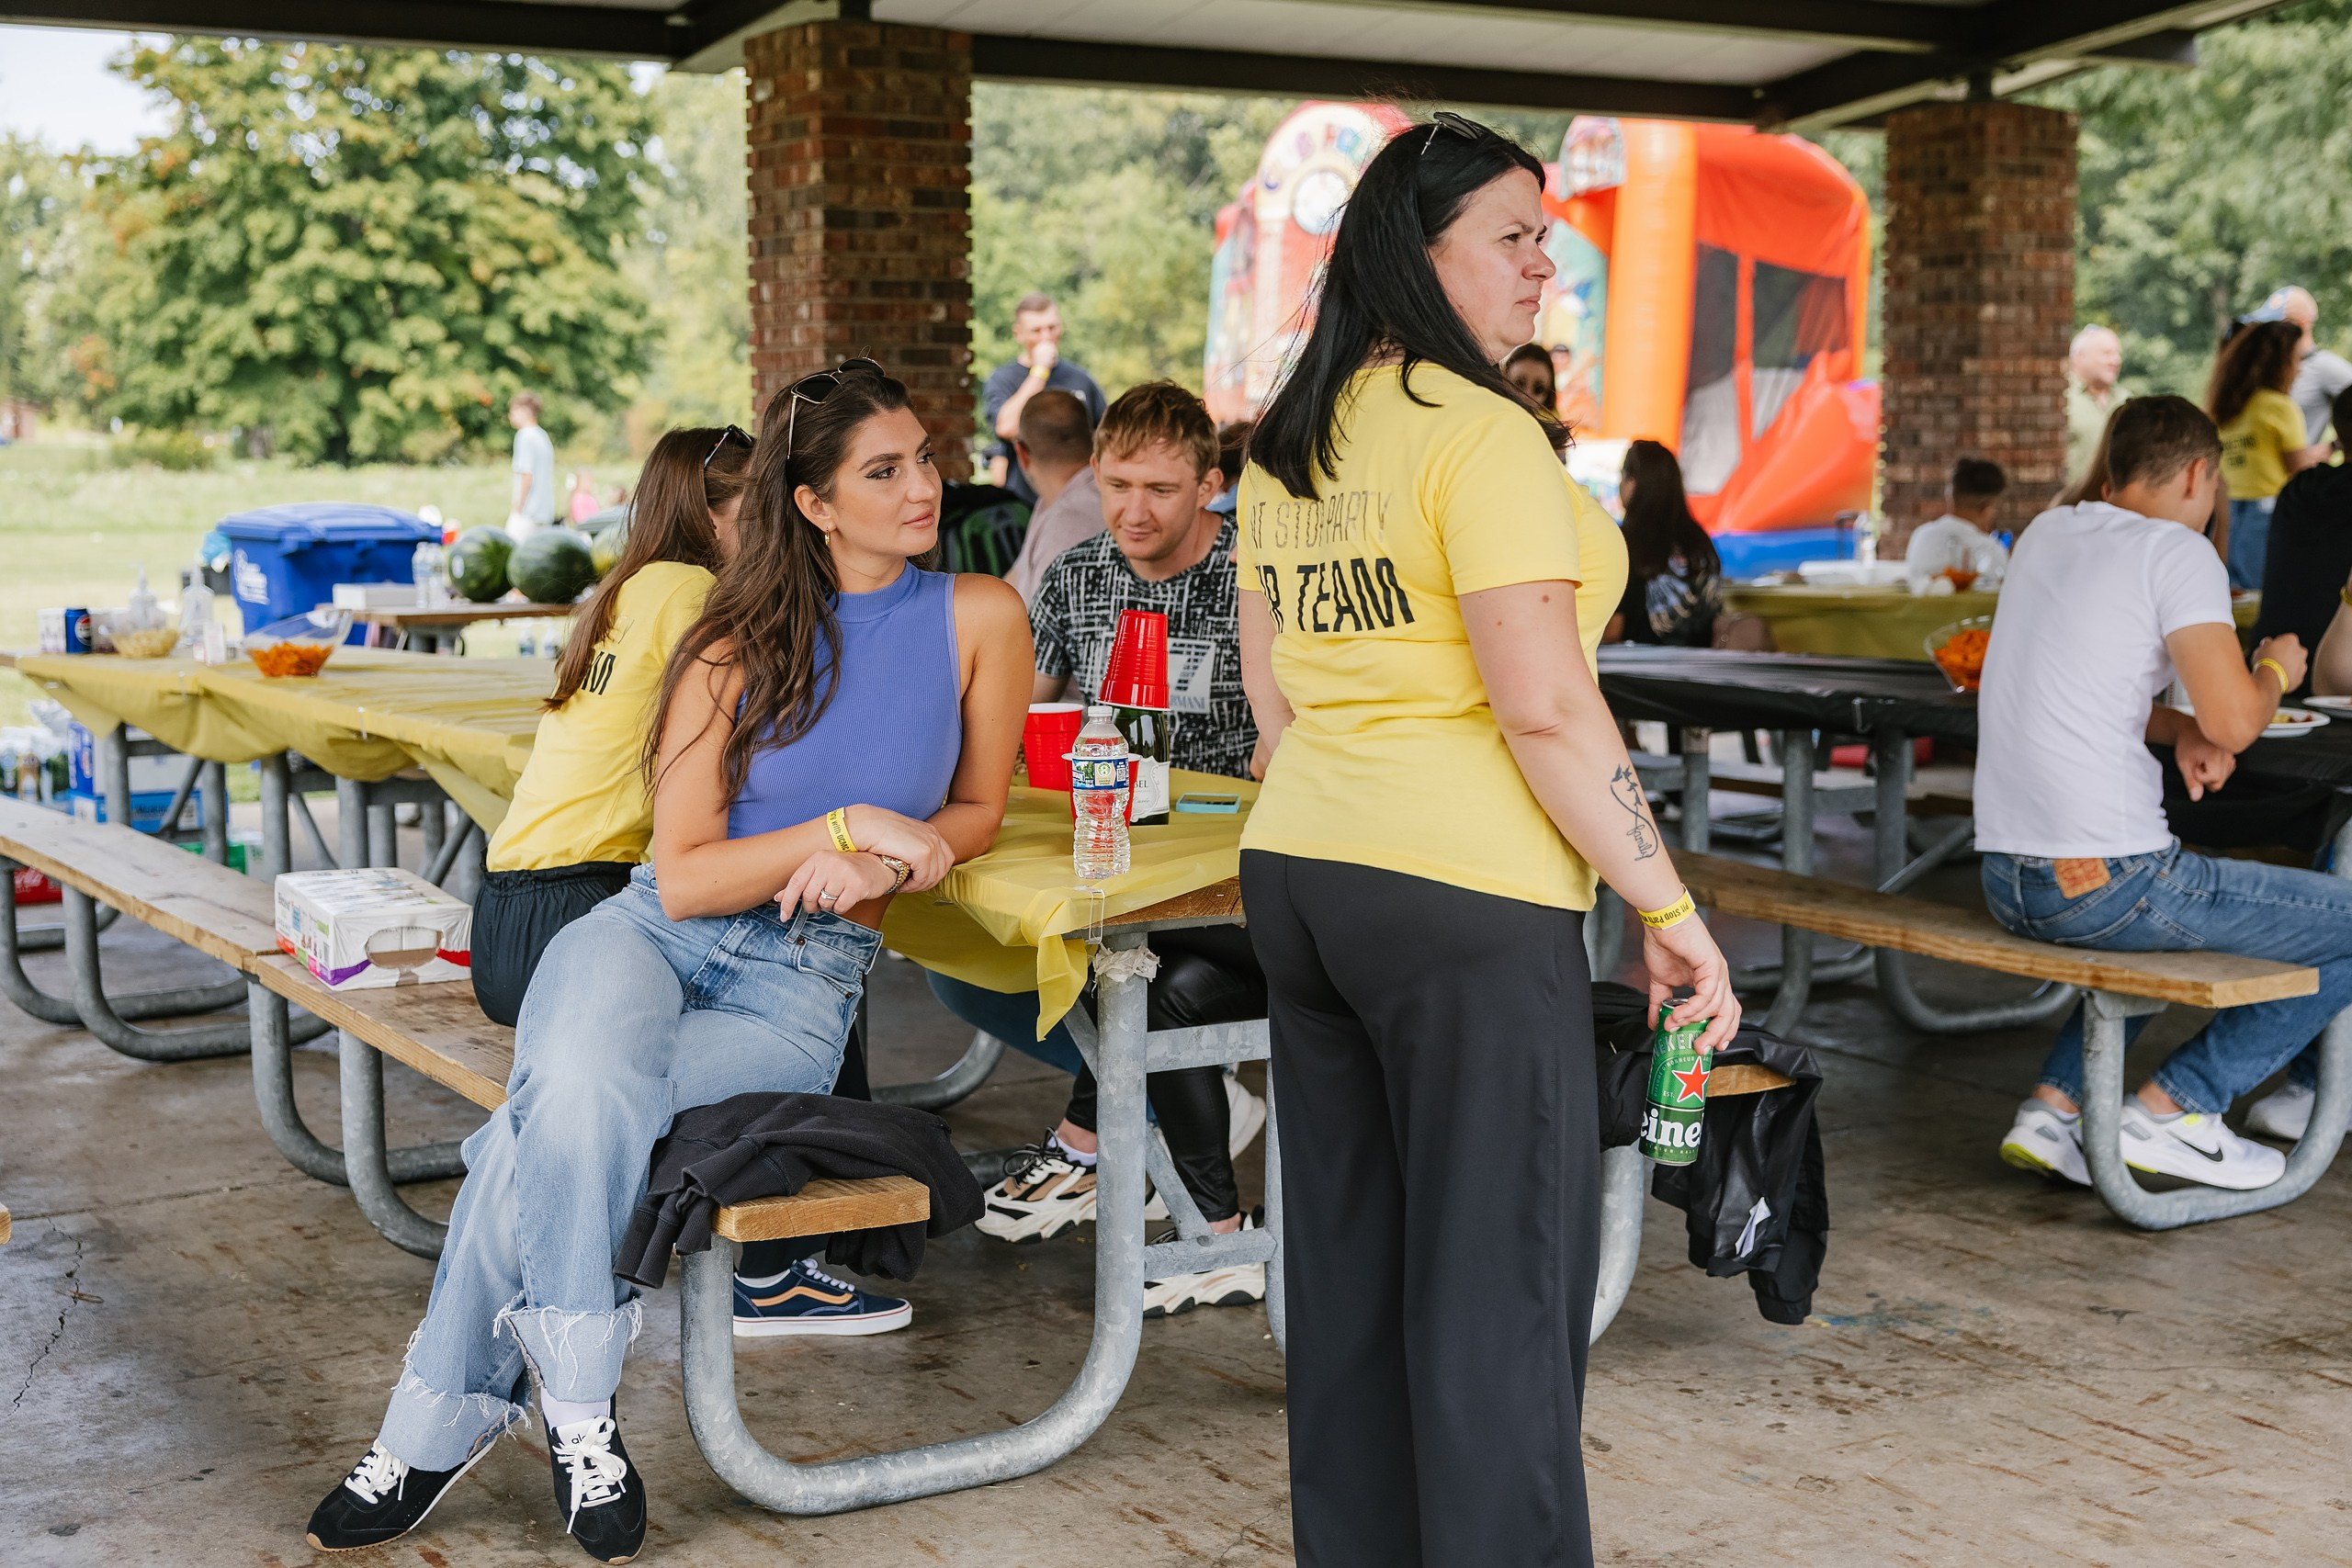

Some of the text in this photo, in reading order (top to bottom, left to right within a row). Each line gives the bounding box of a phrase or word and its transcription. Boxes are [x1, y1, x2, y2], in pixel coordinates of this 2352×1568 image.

[1326, 490, 1393, 545] PARTY
[1296, 558, 1416, 633] TEAM
[1170, 694, 1205, 710] RMANI
[1626, 824, 1653, 861] family
[1664, 908, 1681, 921] Stop
[1641, 1108, 1702, 1148] eine
